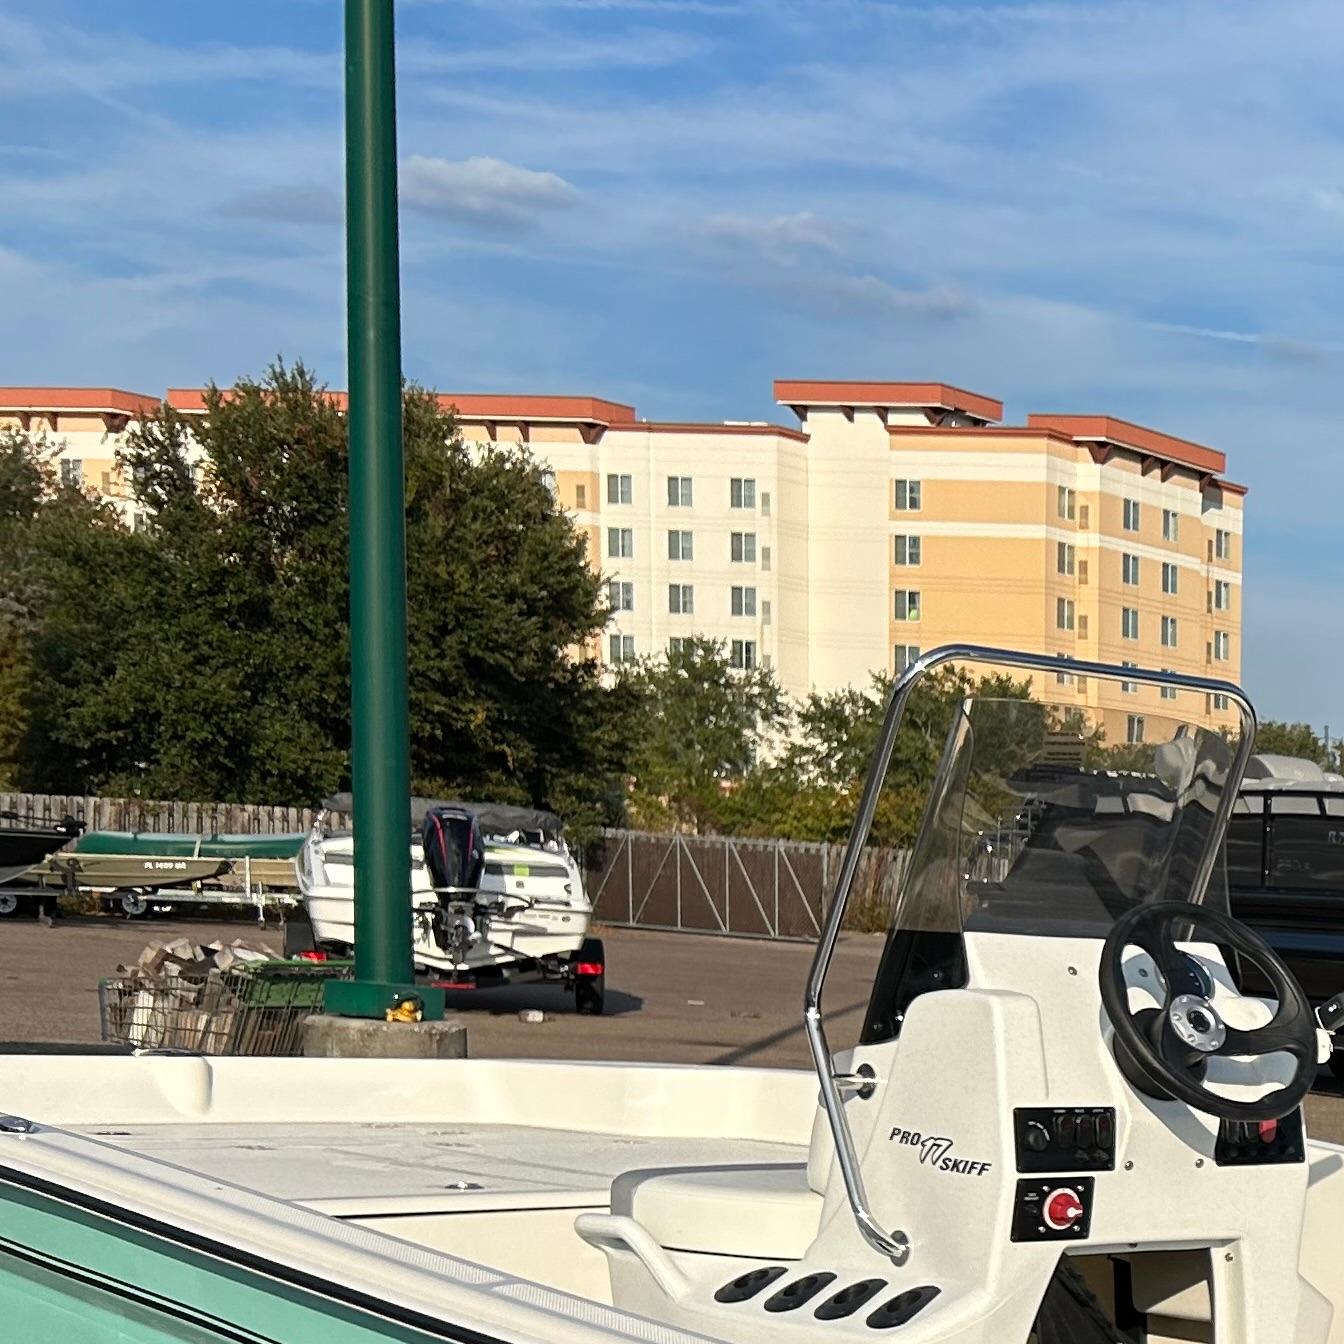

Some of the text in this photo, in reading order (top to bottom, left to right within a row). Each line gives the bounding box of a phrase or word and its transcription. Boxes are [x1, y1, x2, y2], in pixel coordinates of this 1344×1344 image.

[888, 1127, 993, 1176] PRO 17 SKIFF
